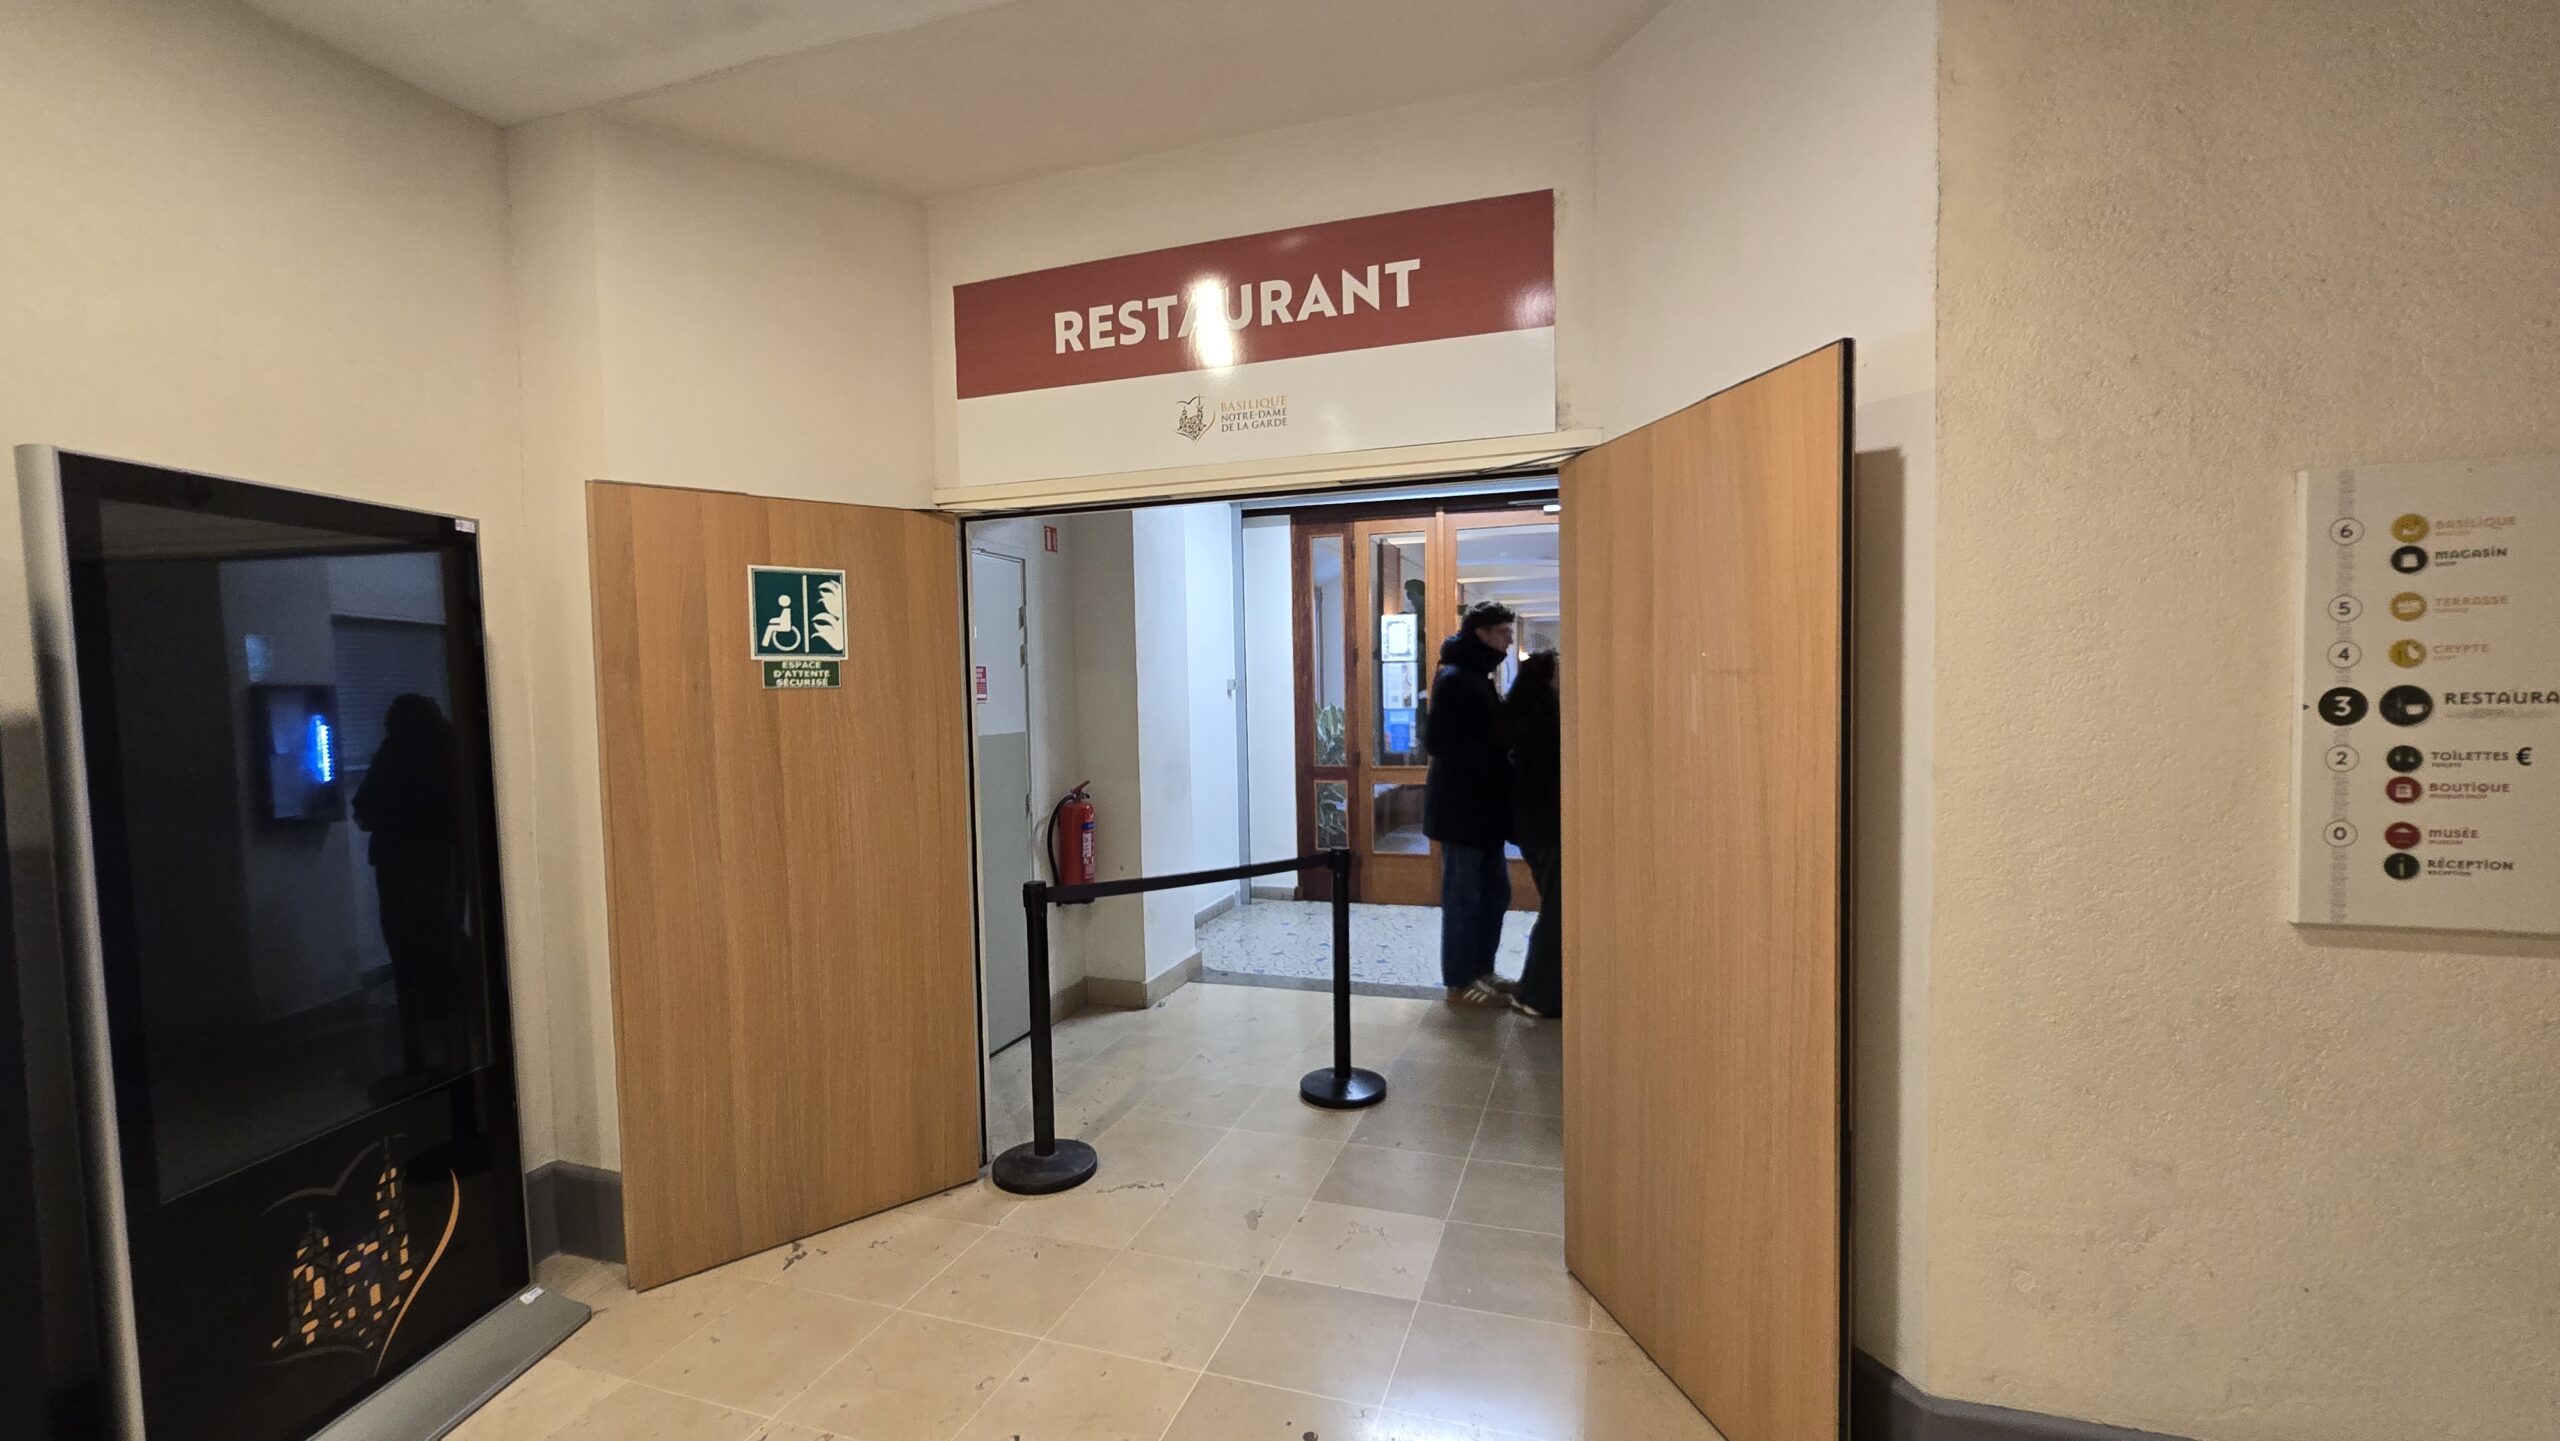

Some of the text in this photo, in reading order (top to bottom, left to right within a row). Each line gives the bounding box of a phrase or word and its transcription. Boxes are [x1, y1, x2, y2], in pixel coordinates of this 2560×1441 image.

[1221, 395, 1287, 412] BASILIQUE
[1221, 407, 1287, 423] NOTRE-DAME
[1221, 417, 1288, 433] DE LA GARDE
[2339, 524, 2353, 539] 6
[2337, 601, 2351, 615] 5
[2434, 596, 2510, 606] TERRASSE
[2337, 647, 2351, 661] 4
[2434, 643, 2489, 653] CRYPTE
[773, 670, 830, 678] D'ATTENTE
[776, 678, 829, 687] SÉCURISÉ
[2334, 696, 2352, 717] 3
[2335, 751, 2348, 766] 2
[2333, 826, 2347, 841] 0
[2428, 857, 2514, 870] RÉCEPTION
